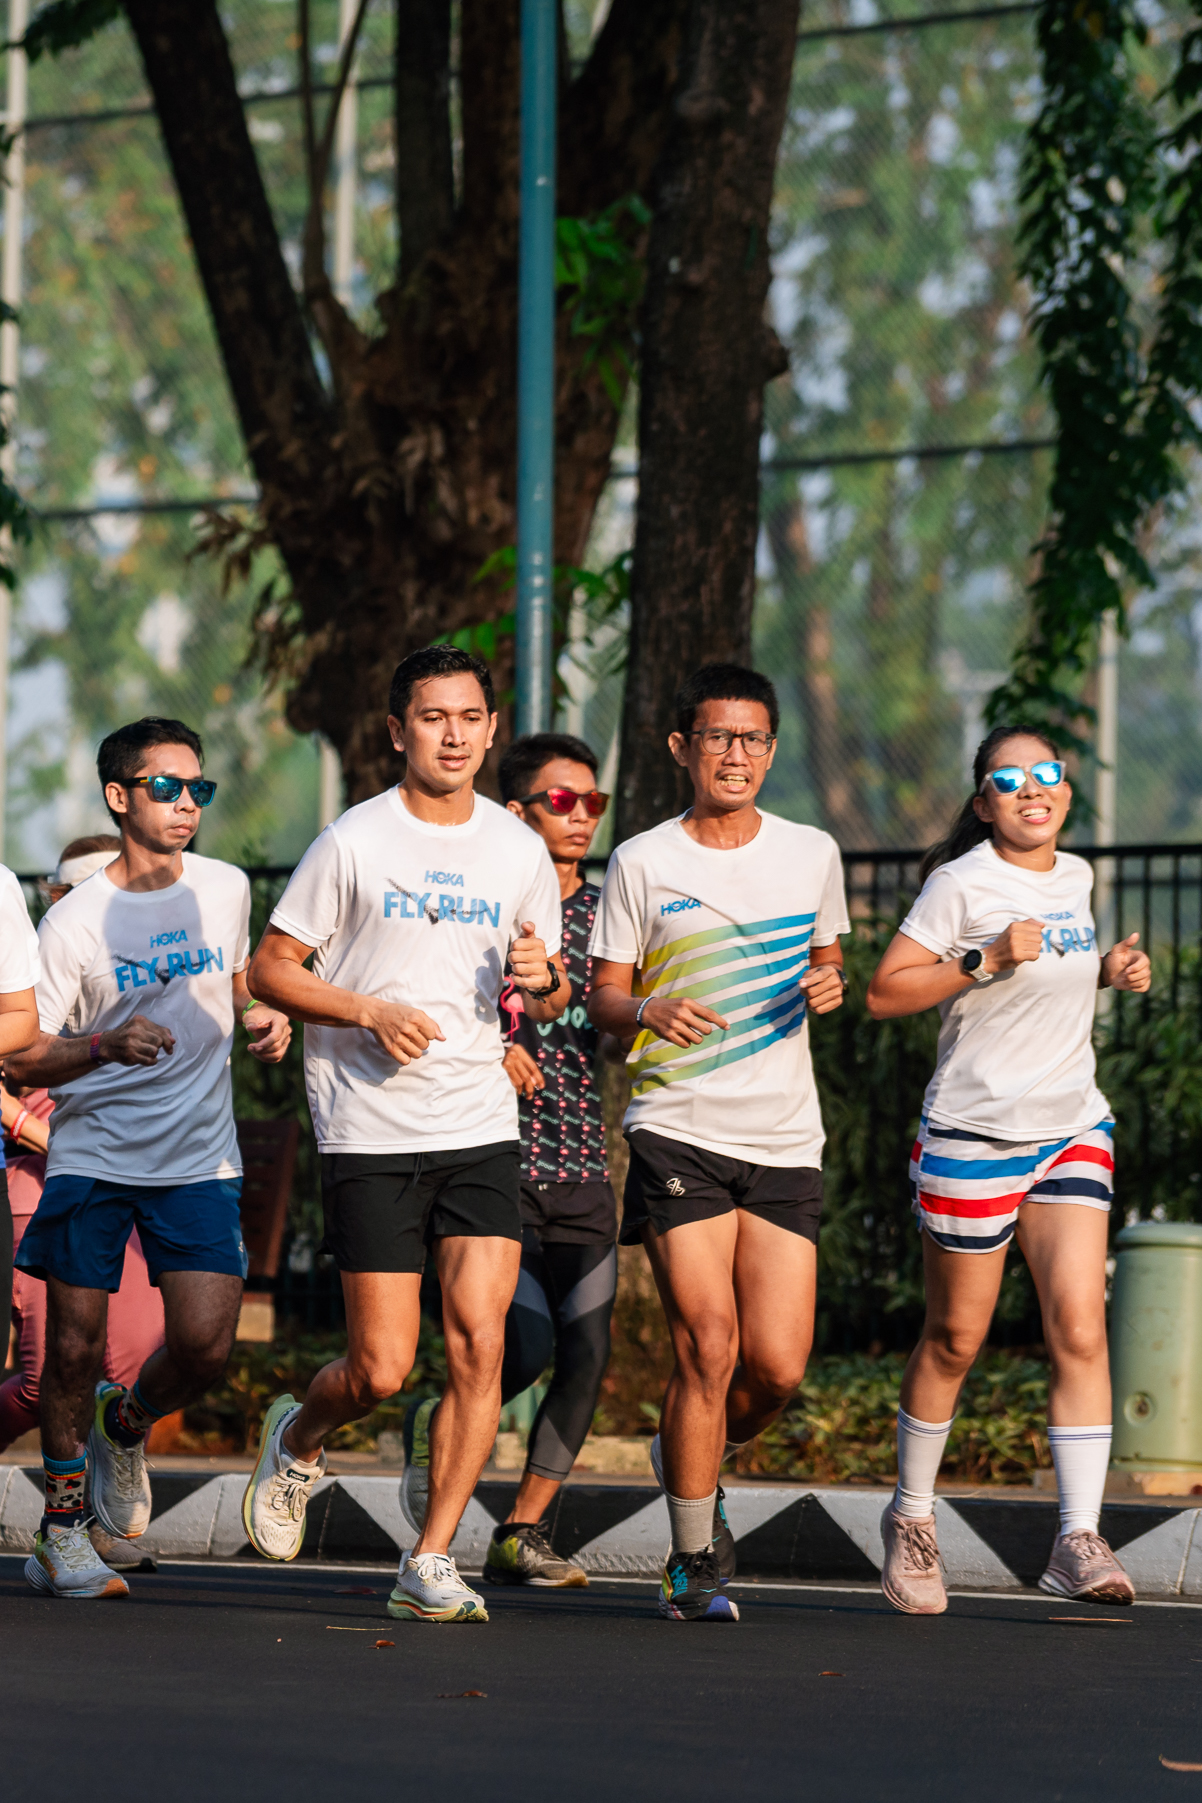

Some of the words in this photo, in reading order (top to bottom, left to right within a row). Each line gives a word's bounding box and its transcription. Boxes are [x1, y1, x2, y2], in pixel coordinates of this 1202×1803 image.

[424, 870, 464, 887] HOKA
[384, 892, 432, 919] FLY
[438, 894, 501, 928] RUN
[661, 898, 702, 917] HOKA
[149, 929, 188, 949] HOKA
[114, 956, 160, 992] FLY
[166, 946, 224, 980] RUN
